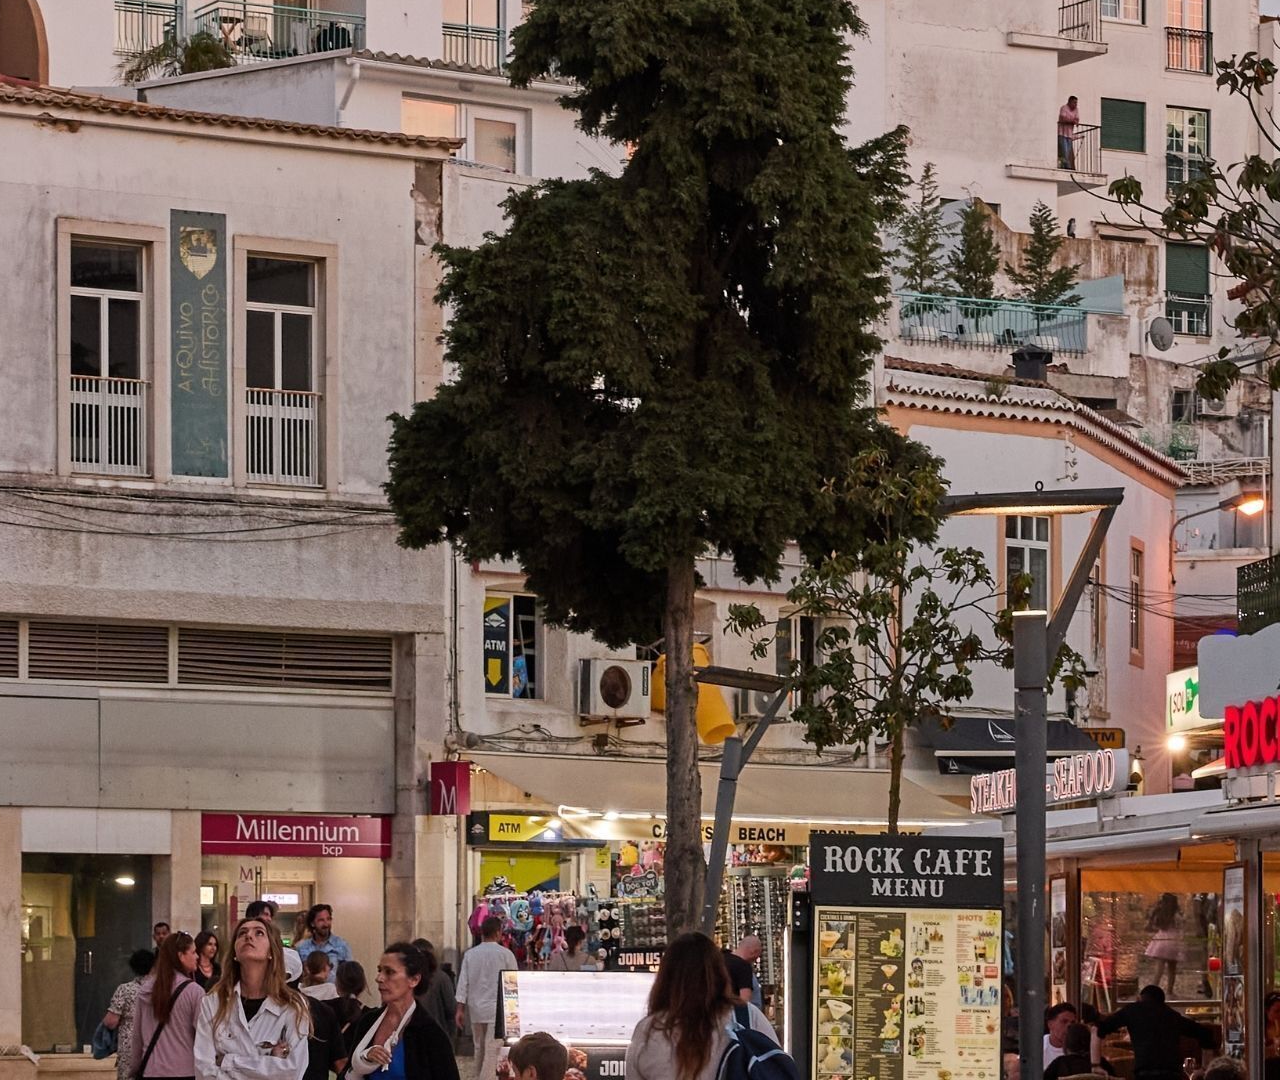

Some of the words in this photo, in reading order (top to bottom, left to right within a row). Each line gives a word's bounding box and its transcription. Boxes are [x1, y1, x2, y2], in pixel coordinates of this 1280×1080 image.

[484, 638, 507, 652] ATM
[1053, 747, 1115, 801] SEAFOOD
[236, 814, 360, 842] Millennium
[498, 822, 521, 834] ATM
[738, 827, 786, 842] BEACH
[322, 844, 343, 857] bcp
[823, 845, 904, 874] ROCK
[913, 848, 992, 877] CAFE
[871, 877, 945, 898] MENU
[618, 952, 644, 966] JOIN
[645, 951, 661, 965] US
[599, 1060, 627, 1076] JOI
